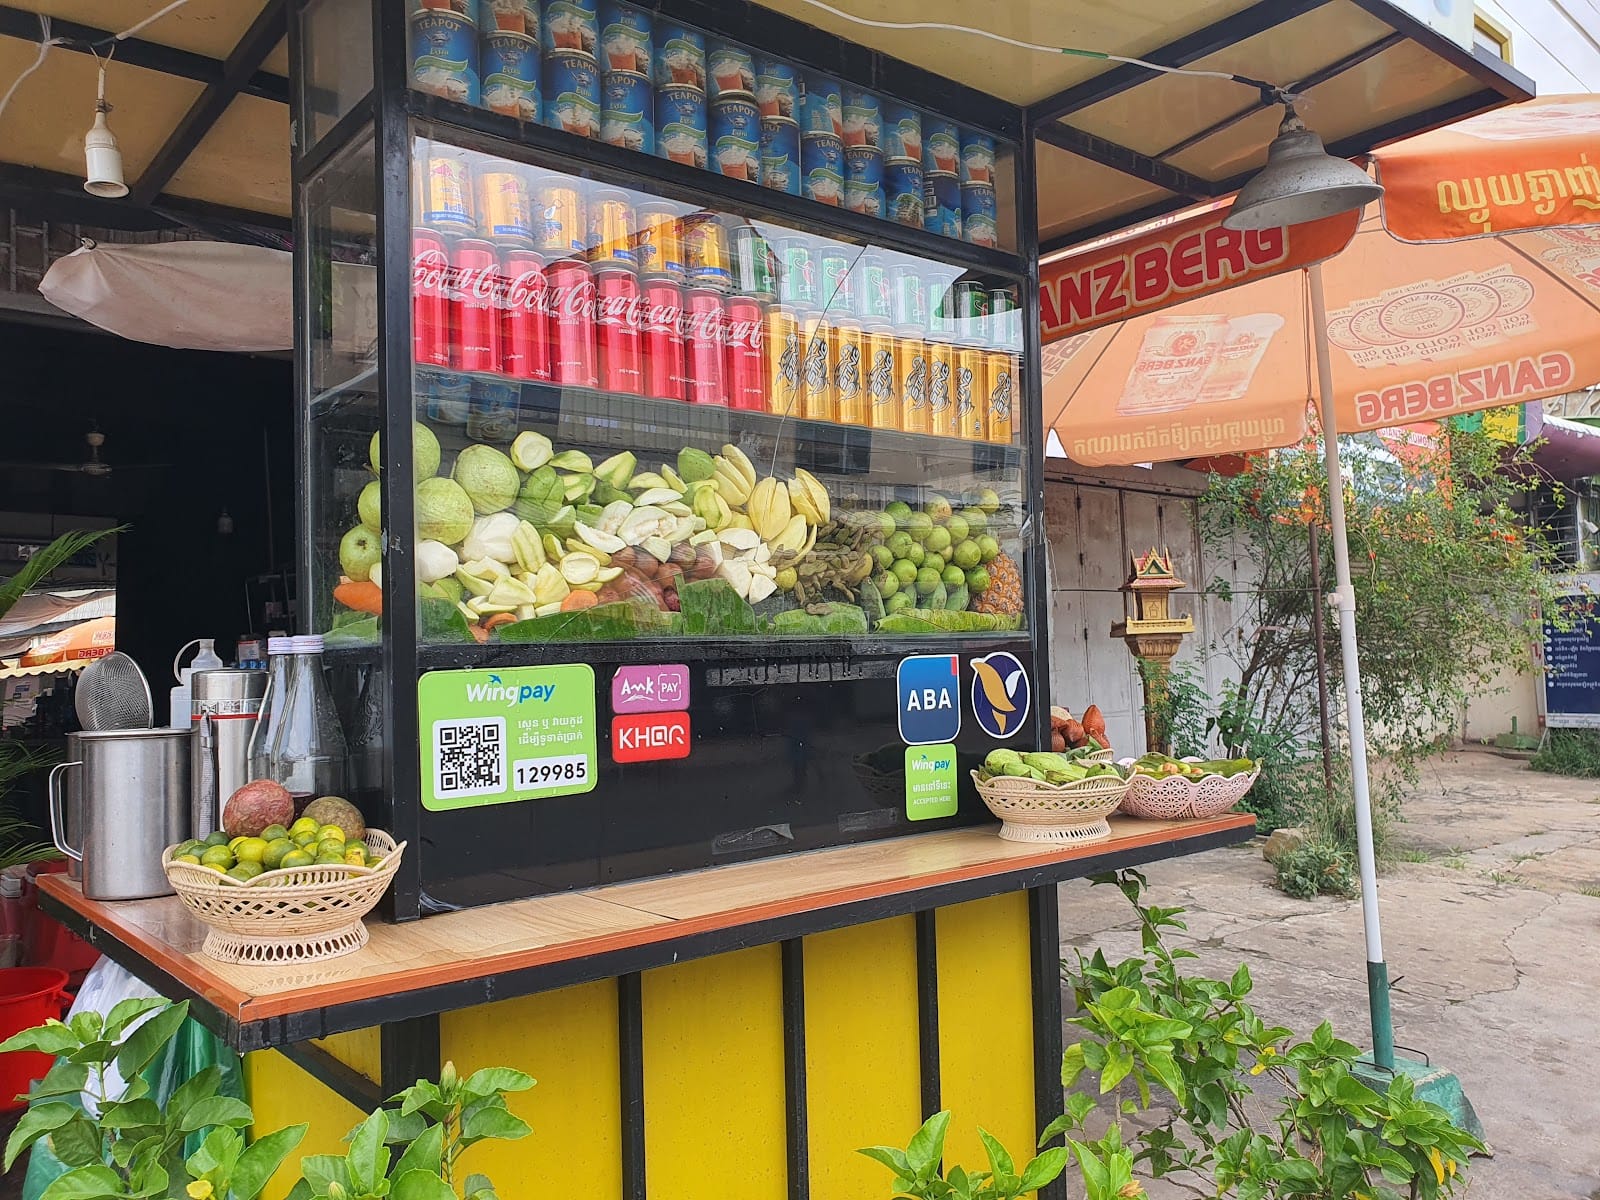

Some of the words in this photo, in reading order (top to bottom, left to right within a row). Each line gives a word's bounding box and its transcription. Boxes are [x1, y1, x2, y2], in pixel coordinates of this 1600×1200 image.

[419, 17, 461, 32] TEAPOT
[491, 37, 531, 53] TEAPOT
[563, 59, 598, 77] TEAPOT
[606, 75, 637, 88] EAPOT
[667, 90, 703, 105] TEAPOT
[721, 105, 755, 118] TEAPOT
[816, 139, 842, 151] TEAPO
[1040, 226, 1283, 330] ANZBERG
[466, 682, 556, 708] Wingpay
[661, 683, 679, 693] PAY
[907, 688, 952, 712] ABA
[619, 725, 685, 750] KHQR
[517, 762, 586, 785] 129985
